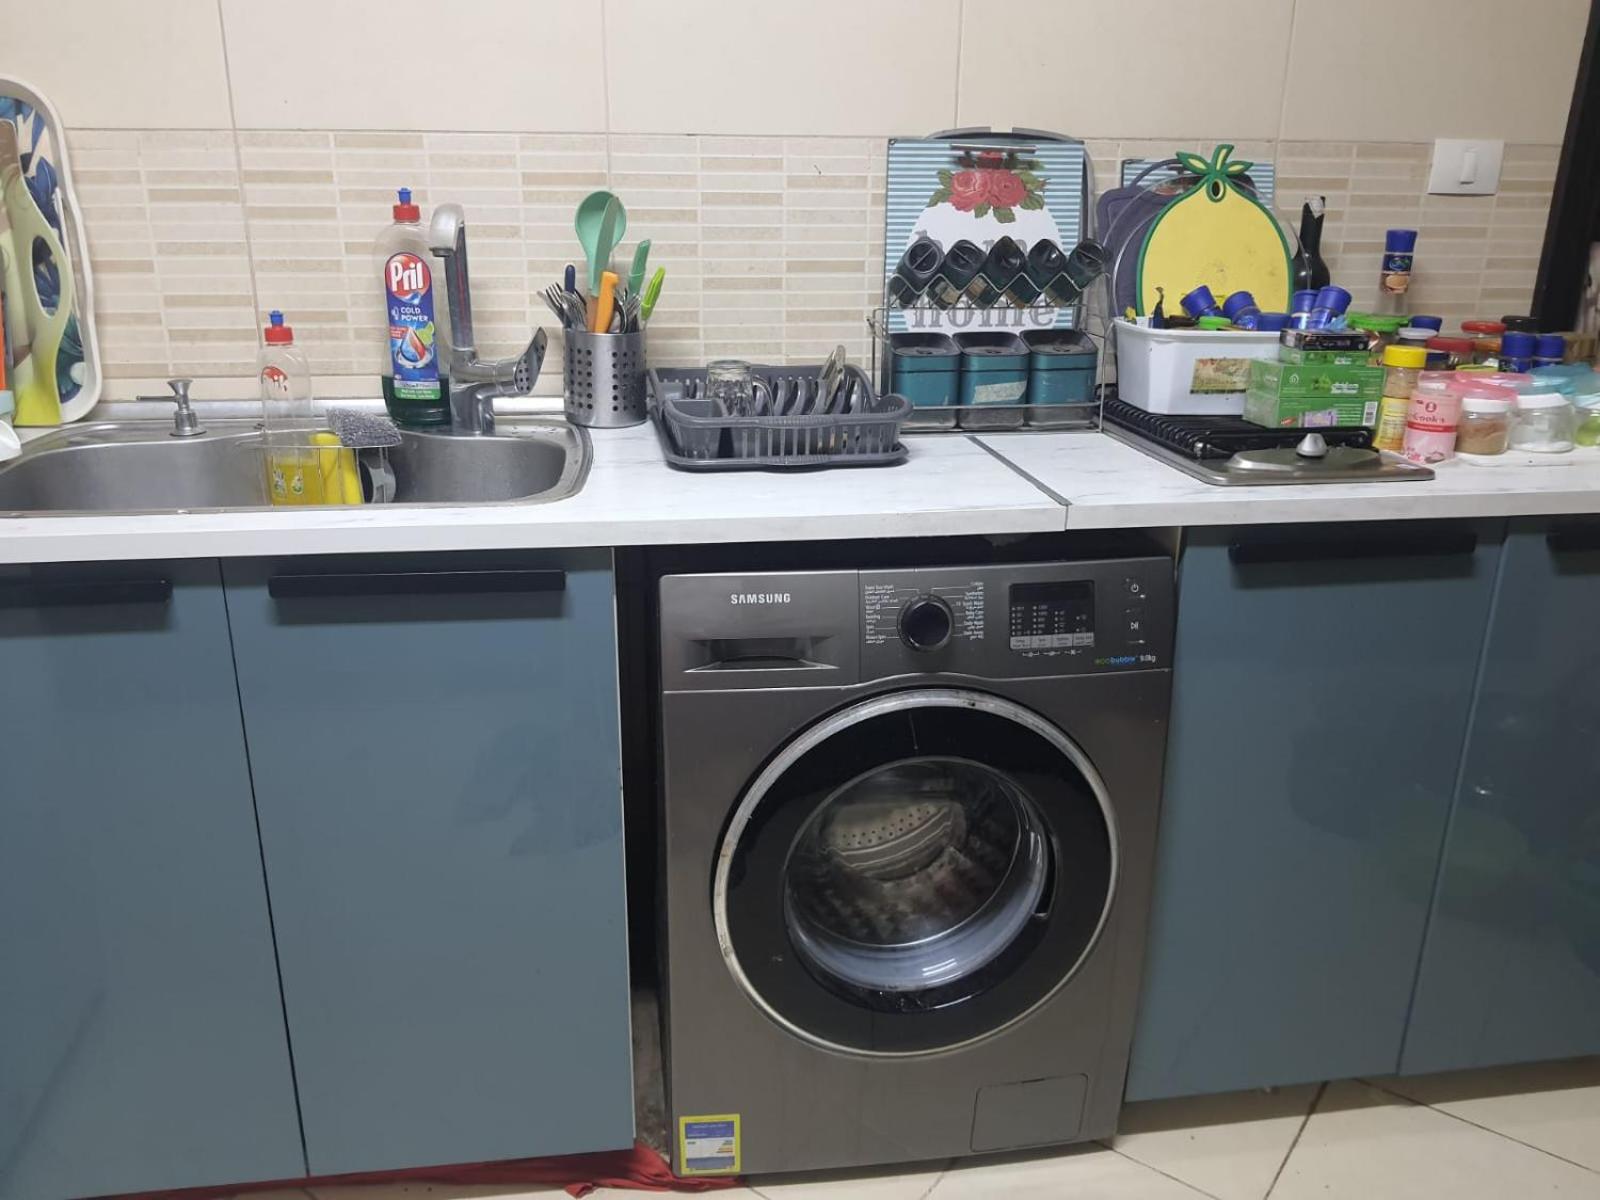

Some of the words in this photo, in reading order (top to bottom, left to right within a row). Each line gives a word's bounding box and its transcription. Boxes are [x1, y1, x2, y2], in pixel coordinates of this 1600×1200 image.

[390, 261, 424, 292] Pril
[400, 306, 421, 314] COLD
[401, 314, 429, 322] POWER
[730, 592, 791, 605] SAMSUNG
